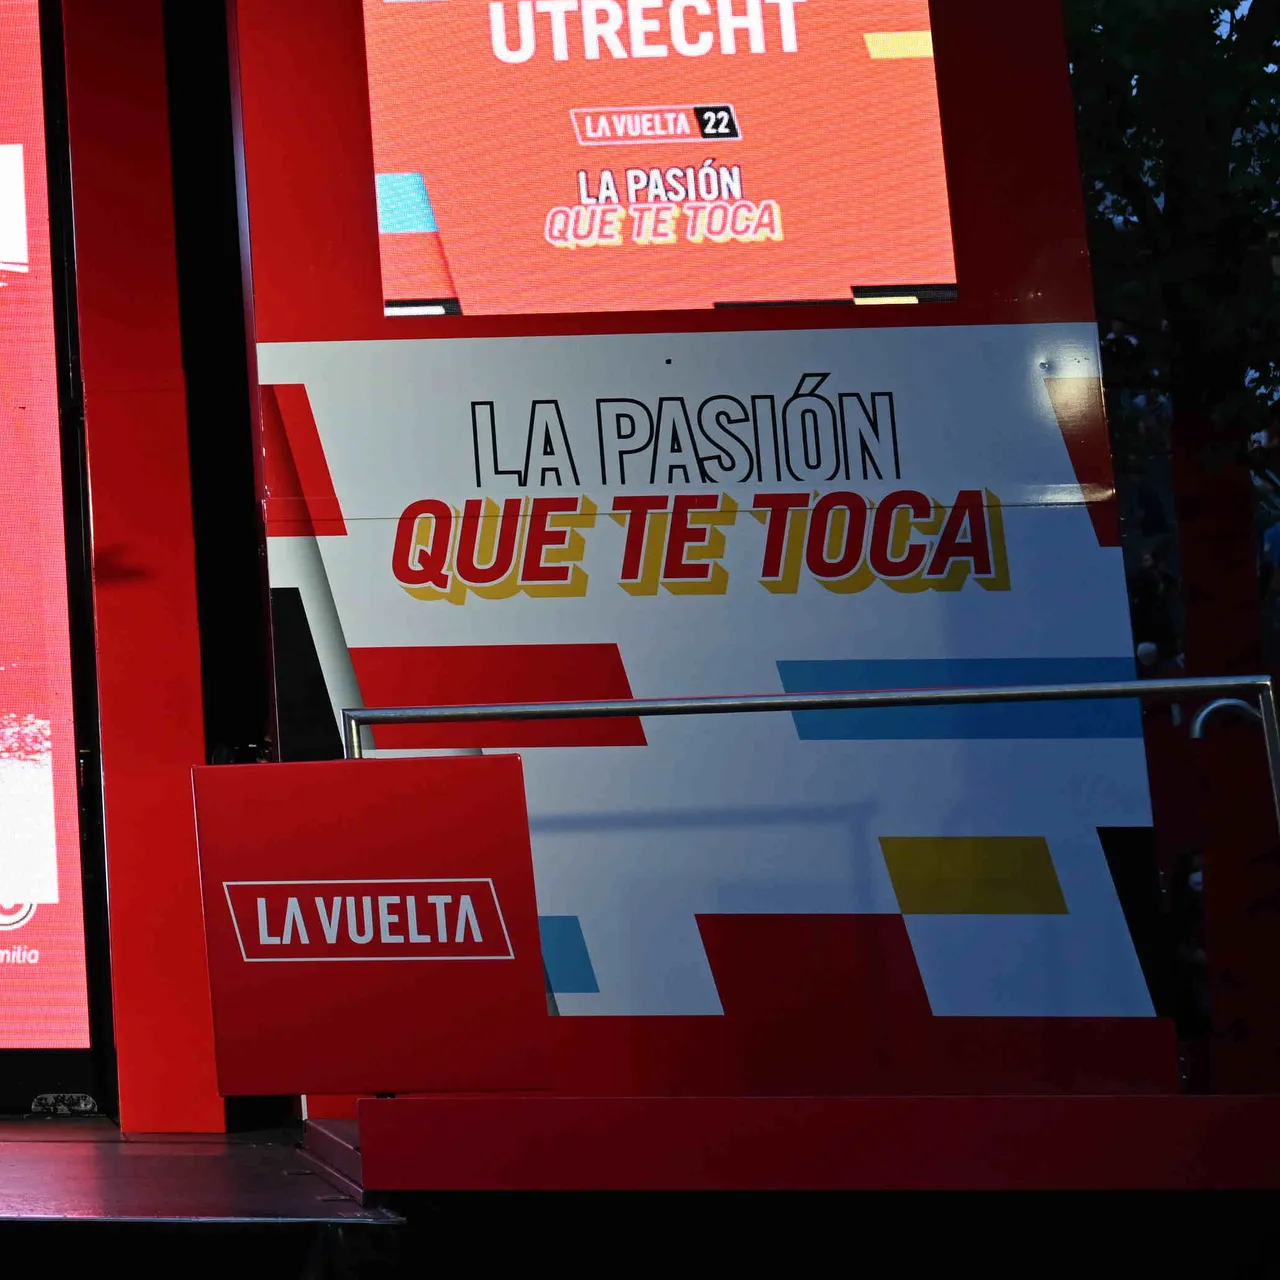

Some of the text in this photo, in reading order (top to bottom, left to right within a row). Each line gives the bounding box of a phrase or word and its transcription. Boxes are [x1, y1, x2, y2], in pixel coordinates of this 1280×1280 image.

[585, 111, 730, 137] LA VUELTA 22
[577, 158, 743, 205] LA PASIÓN
[545, 199, 784, 249] QUE TE TOCA
[470, 372, 902, 488] LA PASIÓN
[390, 488, 1002, 600] QUE TE TOCA
[257, 895, 484, 944] LA VUELTA
